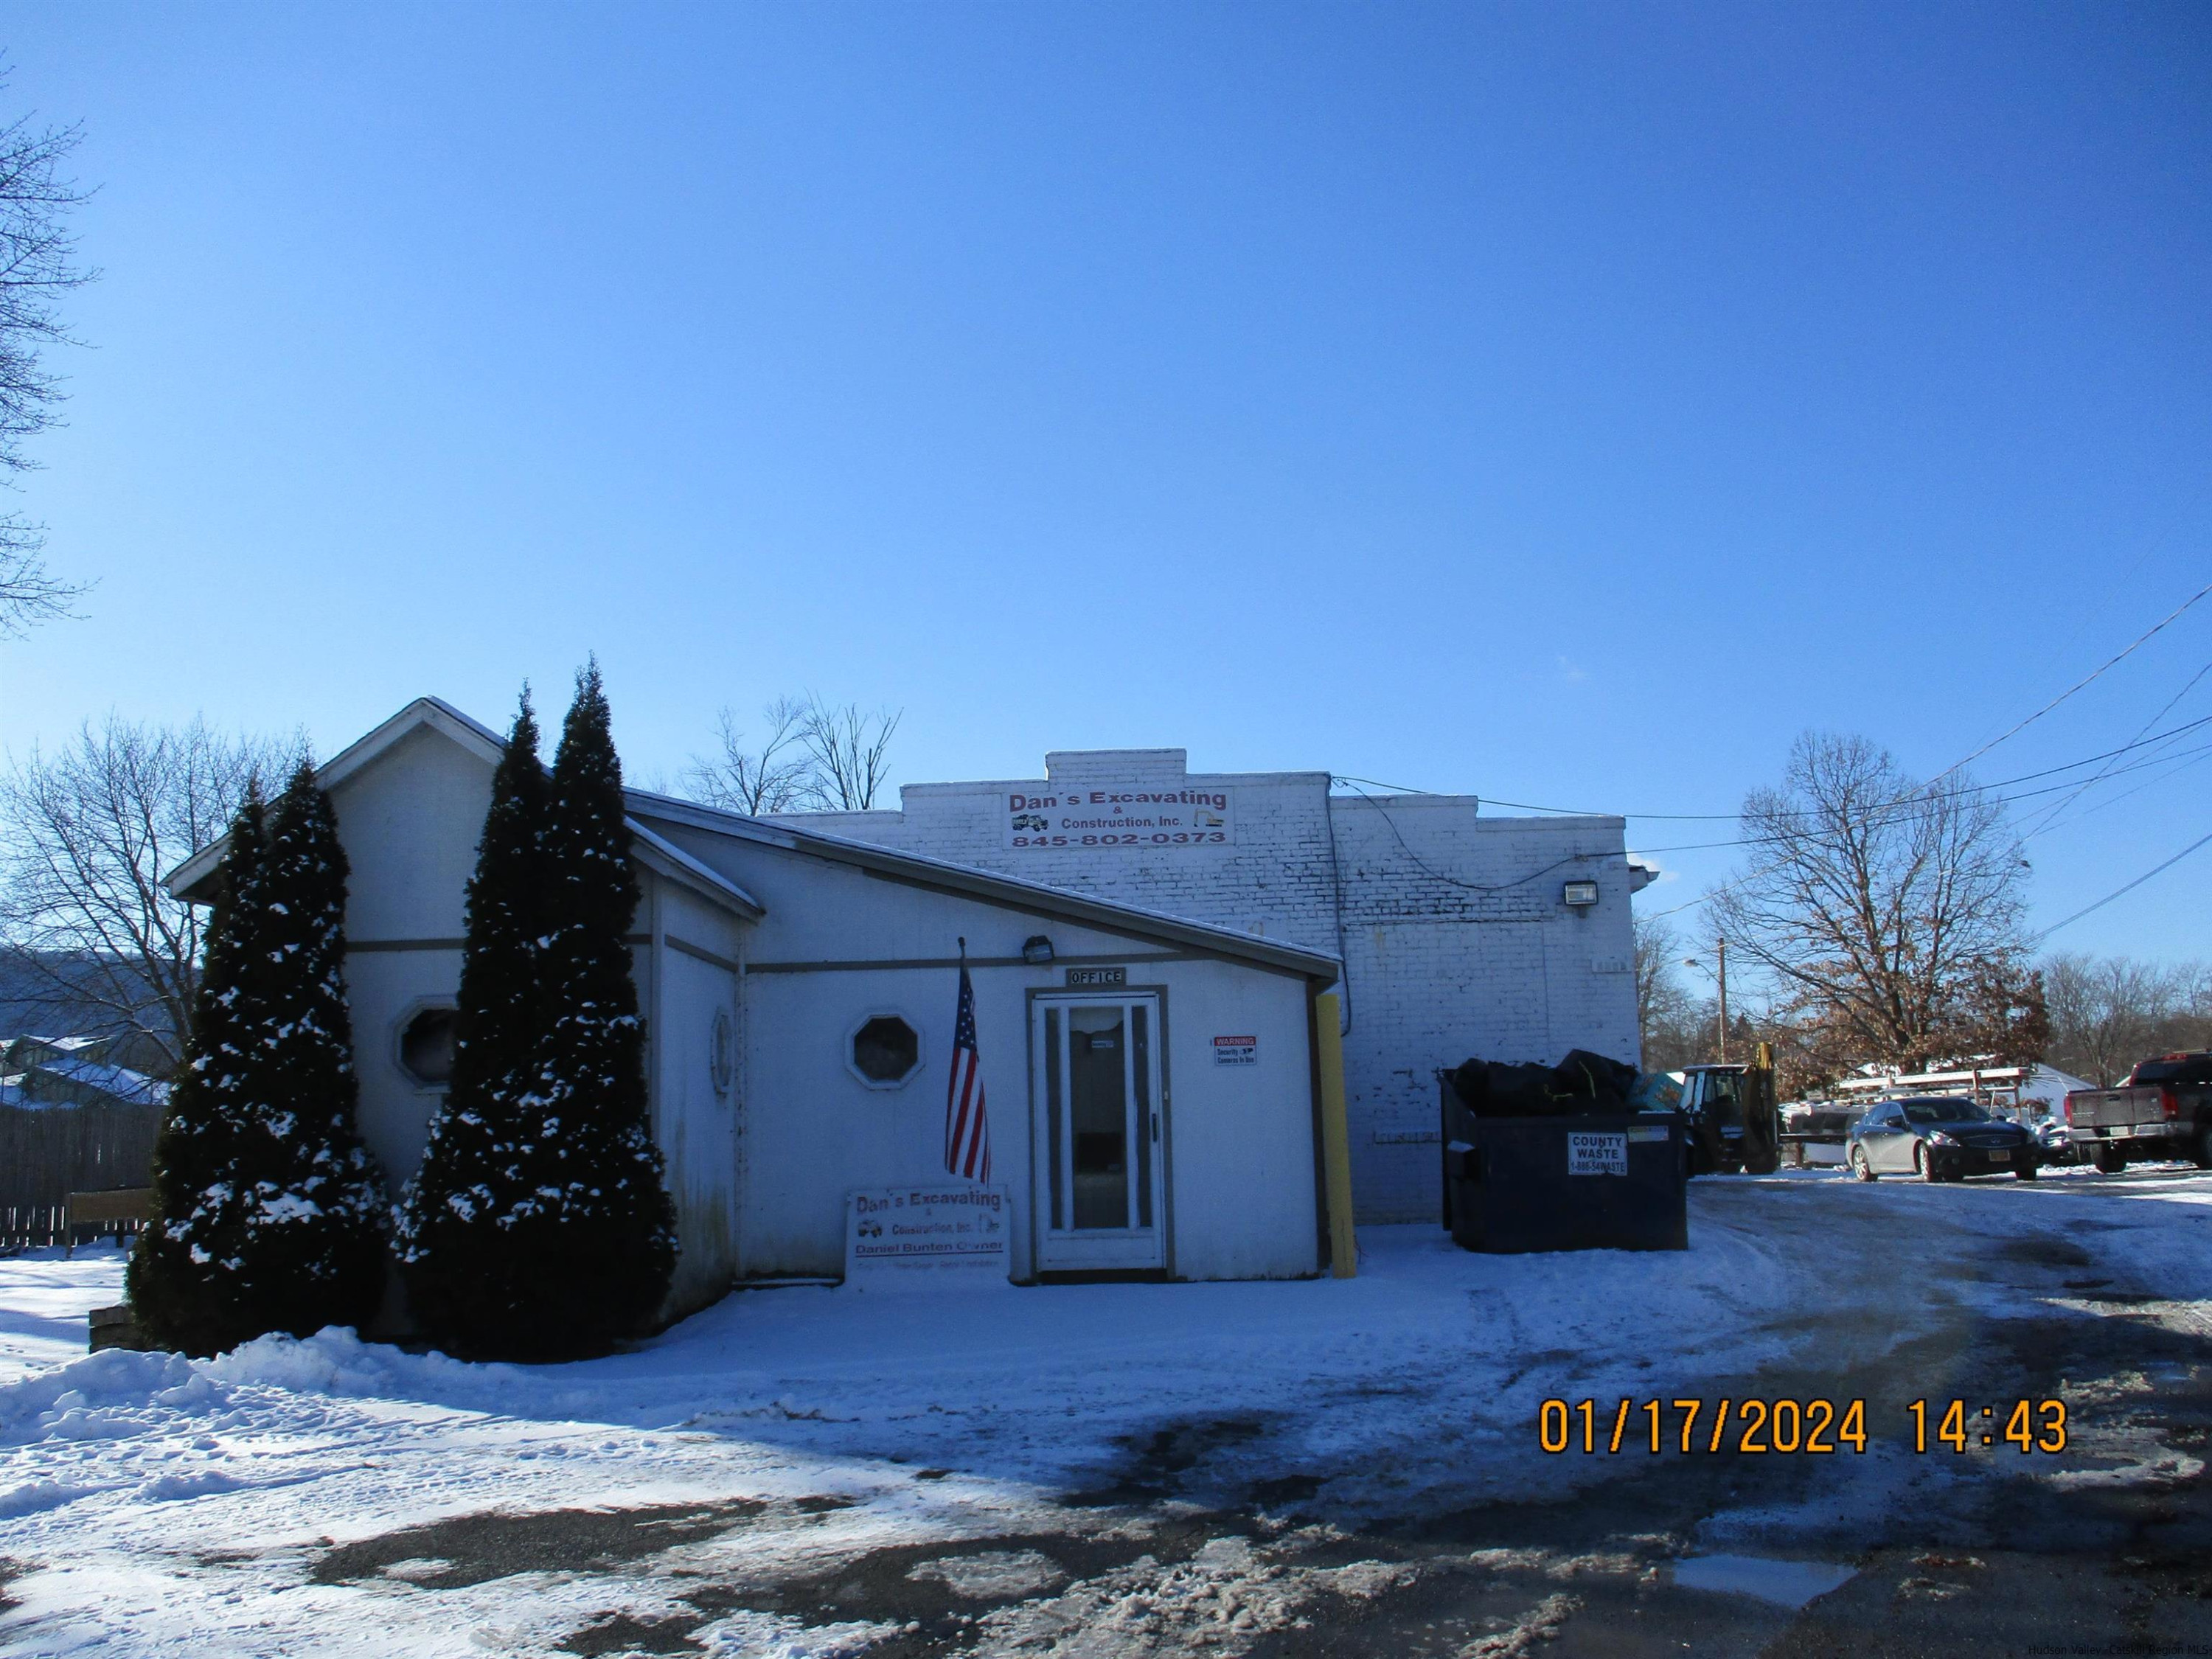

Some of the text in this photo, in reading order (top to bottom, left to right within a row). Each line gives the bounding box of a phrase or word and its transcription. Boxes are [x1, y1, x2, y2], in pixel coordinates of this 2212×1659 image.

[1009, 790, 1226, 812] Dan's Excavating
[1113, 806, 1123, 814] &
[1061, 815, 1183, 830] Construction, Inc.
[1012, 832, 1226, 847] 845-802-0373
[1072, 971, 1121, 983] OFFICE
[1217, 1037, 1254, 1046] WARNING
[1217, 1048, 1239, 1057] Security
[1573, 1136, 1622, 1147] COUNTY
[1577, 1149, 1618, 1159] WASTE
[909, 1190, 1001, 1212] Excavating
[855, 1243, 899, 1254] Daniel
[903, 1242, 953, 1252] Bunten
